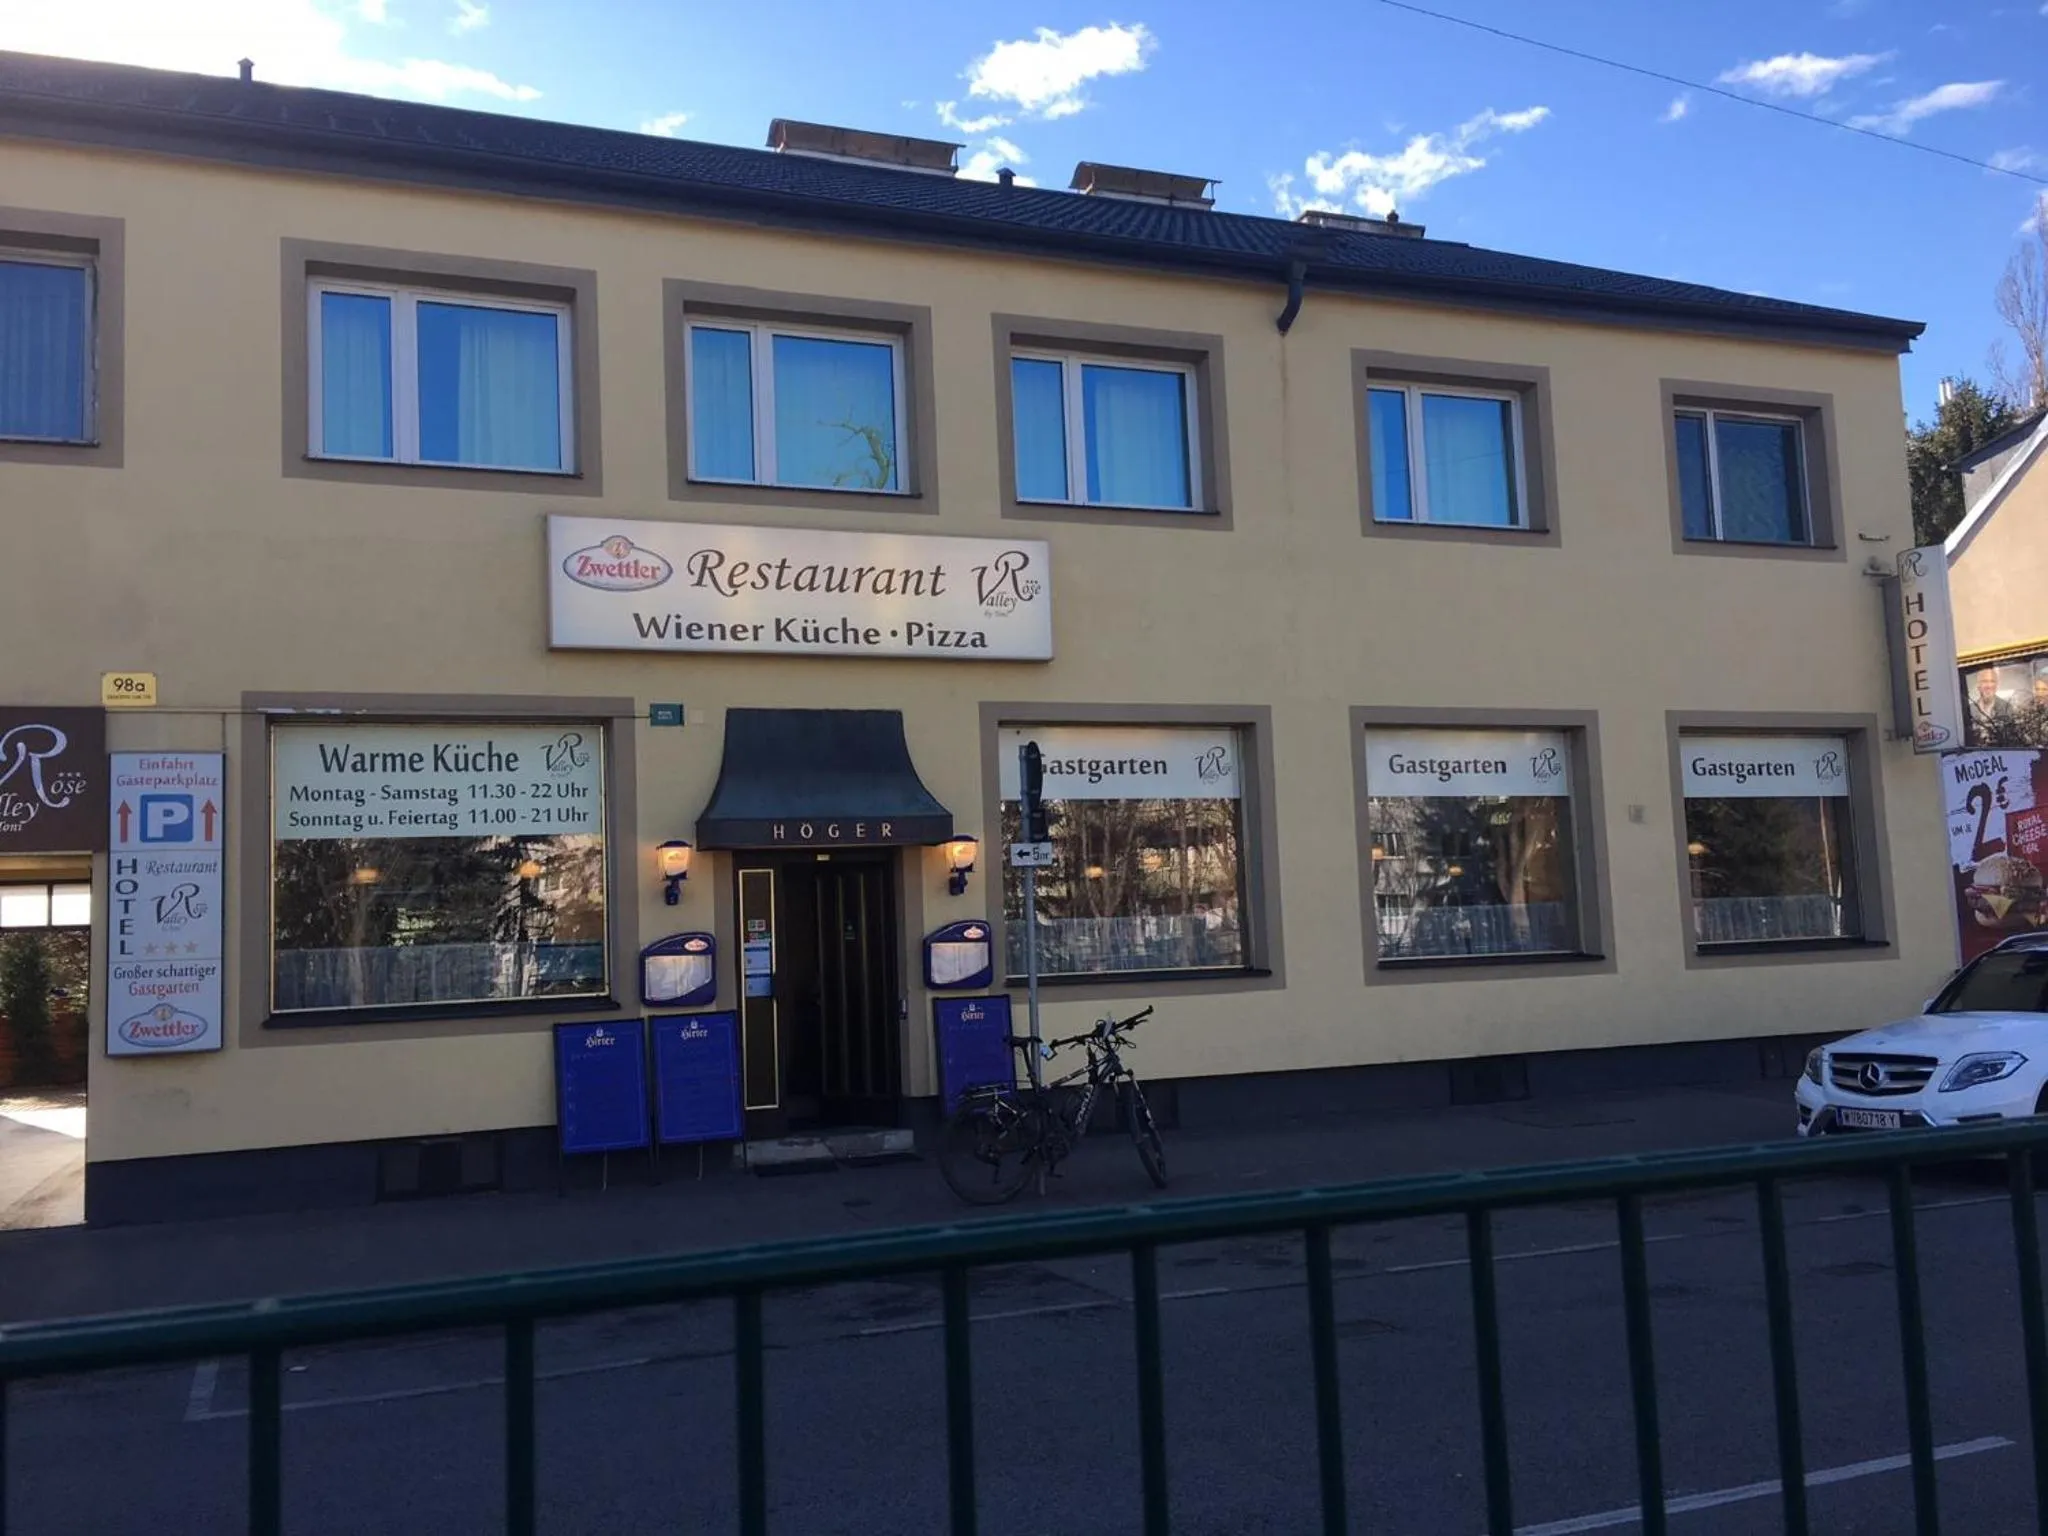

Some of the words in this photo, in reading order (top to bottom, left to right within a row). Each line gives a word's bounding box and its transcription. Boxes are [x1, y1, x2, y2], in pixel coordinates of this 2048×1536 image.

[575, 555, 661, 579] Zwettler
[687, 549, 946, 598] Restaurant
[633, 612, 764, 641] Wiener
[775, 617, 881, 646] Küche
[906, 622, 988, 648] Pizza
[1905, 592, 1932, 717] HOTEL
[113, 677, 146, 692] 98a
[139, 757, 195, 770] Einfahrt
[318, 743, 425, 774] Warme
[433, 740, 520, 773] Küche
[1040, 754, 1168, 784] astgarten
[1389, 754, 1507, 783] Gastgarten
[1692, 757, 1796, 784] Gastgarten
[289, 785, 366, 808] Montag
[380, 784, 458, 806] Samstag
[467, 783, 516, 799] 11.30
[531, 783, 552, 799] 22
[557, 781, 589, 799] Uhr
[288, 811, 364, 832] Sonntag
[368, 814, 384, 826] u.
[388, 810, 458, 830] Feiertag
[468, 808, 517, 824] 11.00
[531, 808, 551, 823] 21
[557, 806, 590, 823] Uhr
[773, 821, 892, 839] HÖGER
[144, 859, 218, 876] Restaurant
[114, 857, 139, 956] HOTEL
[113, 966, 154, 980] Großer
[156, 964, 217, 982] schattiger
[128, 979, 200, 1000] Gastgarten
[128, 1021, 200, 1039] Zwettler
